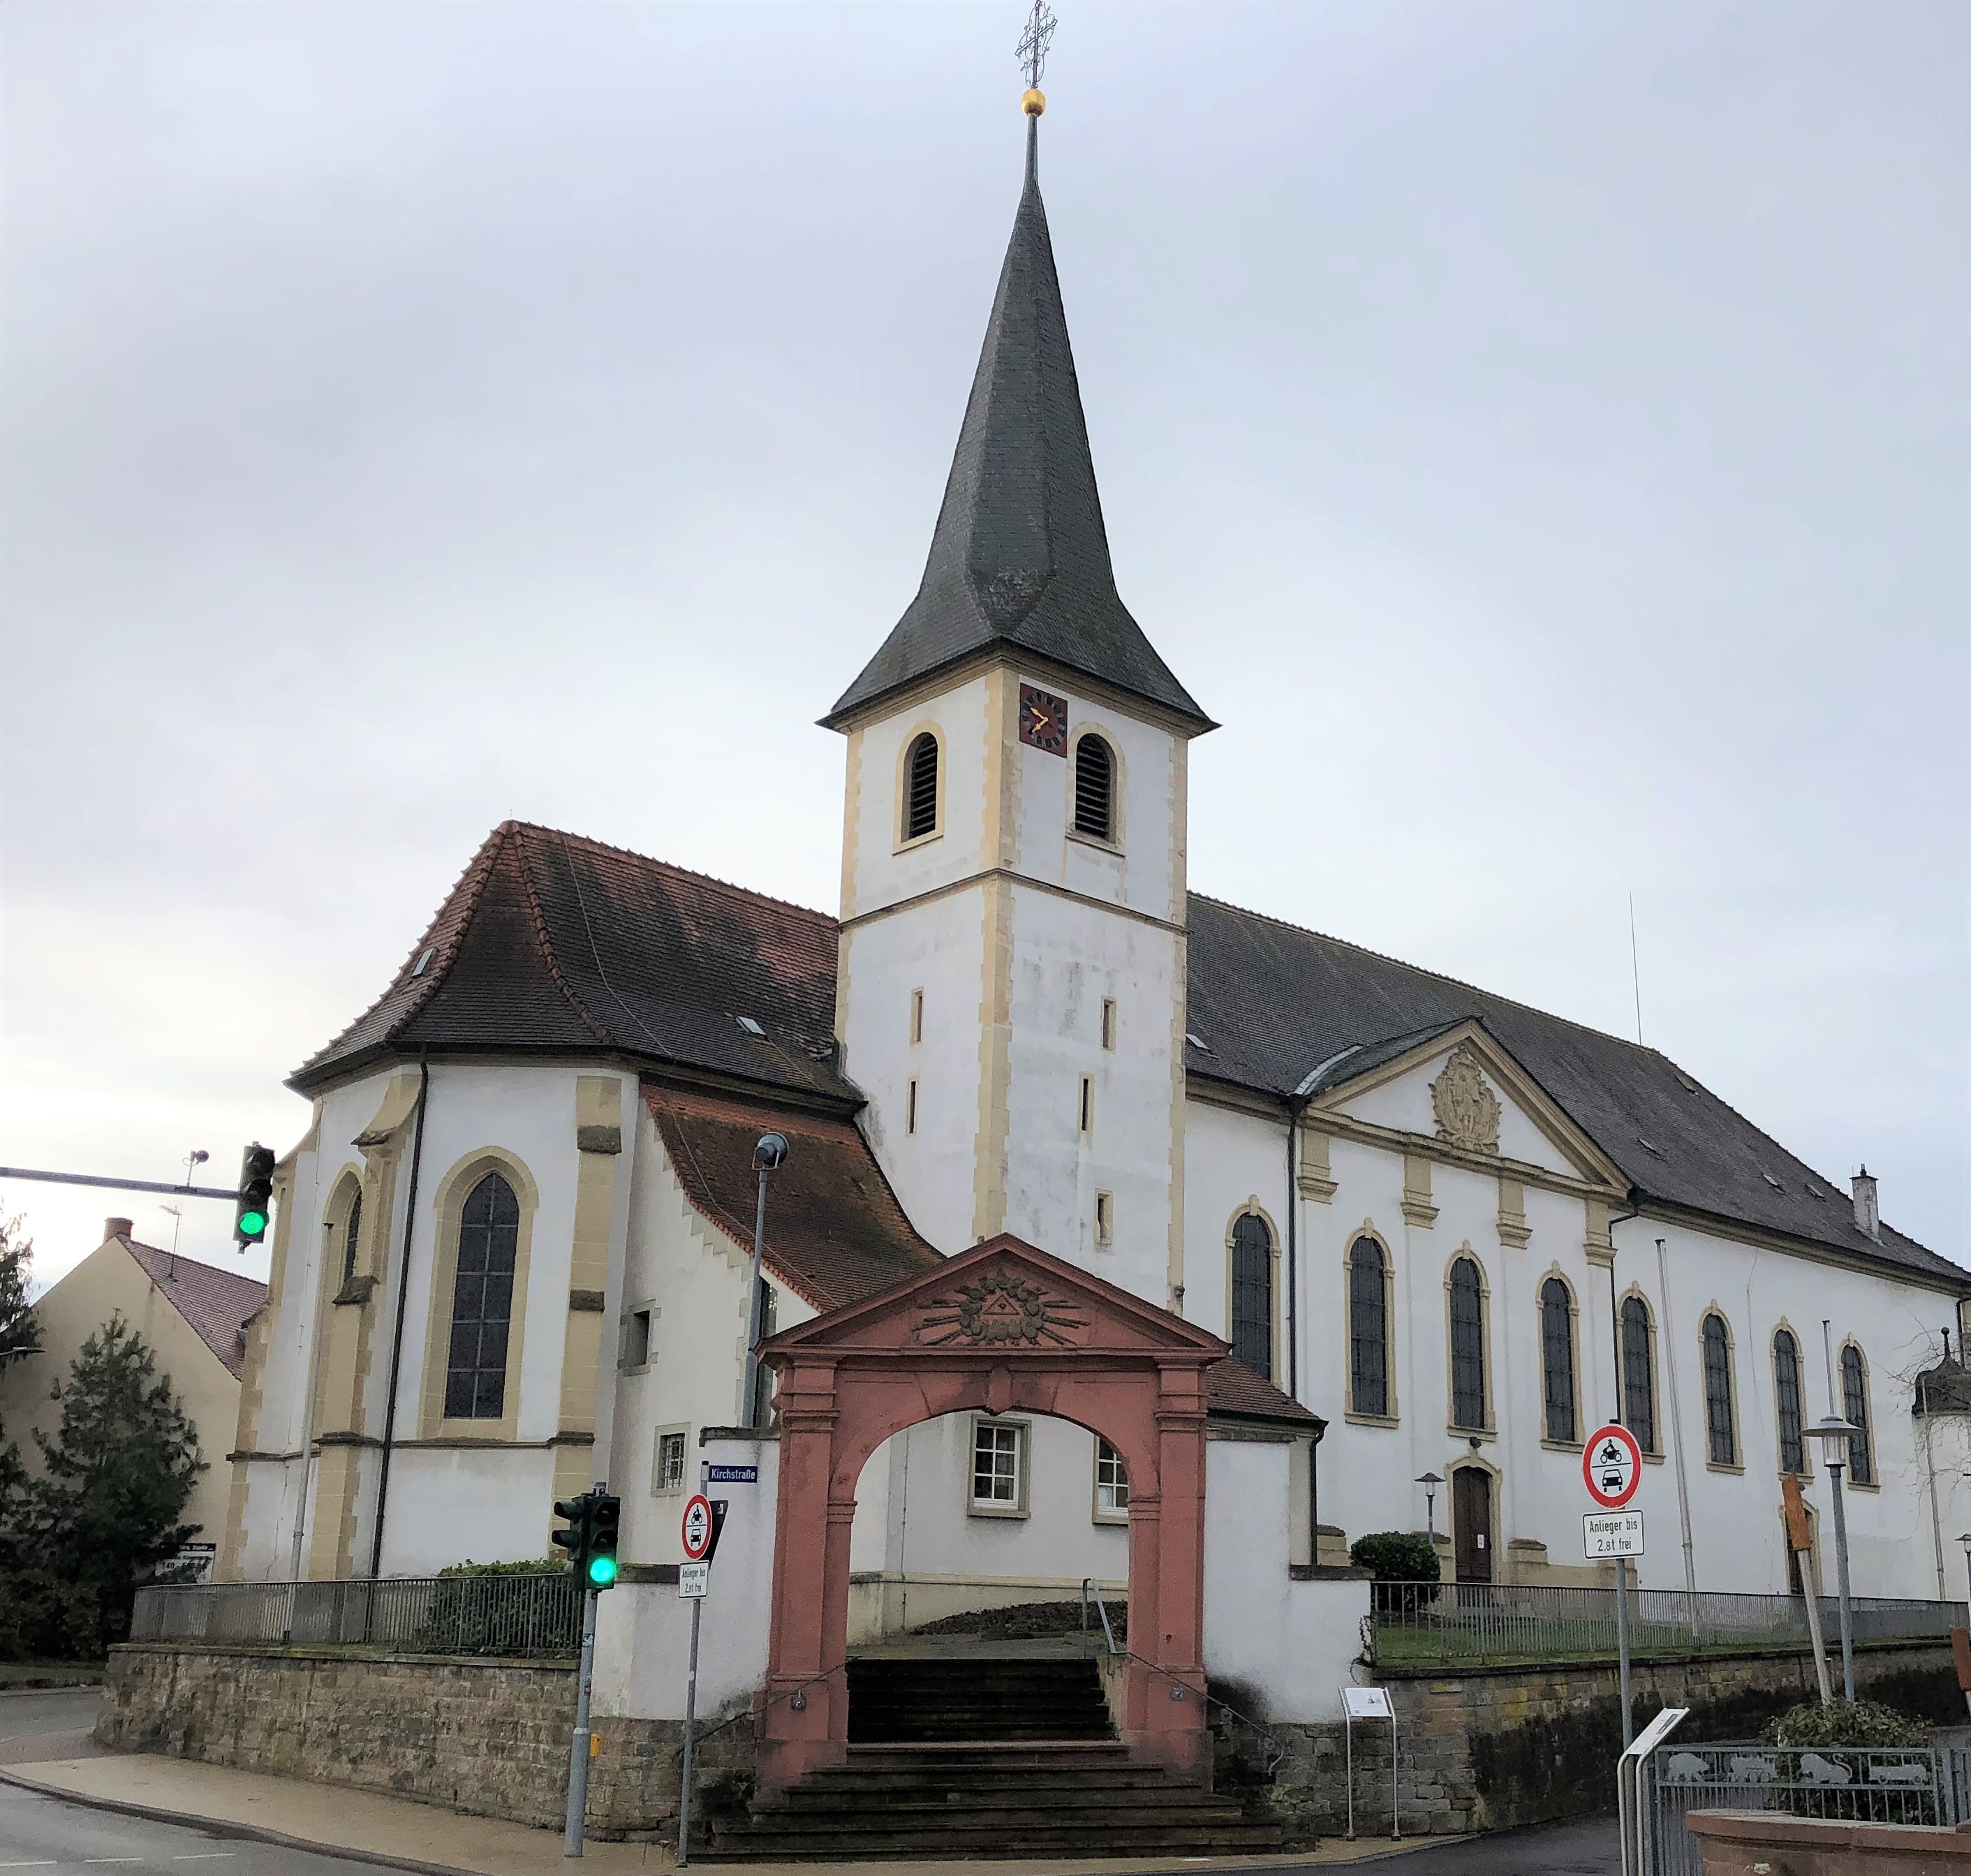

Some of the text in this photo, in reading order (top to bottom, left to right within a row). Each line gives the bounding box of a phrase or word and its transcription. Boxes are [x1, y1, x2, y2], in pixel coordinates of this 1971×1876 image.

[711, 1468, 755, 1479] Kirchstraße
[1590, 1517, 1637, 1535] Anlieger bis
[1619, 1537, 1631, 1550] frei
